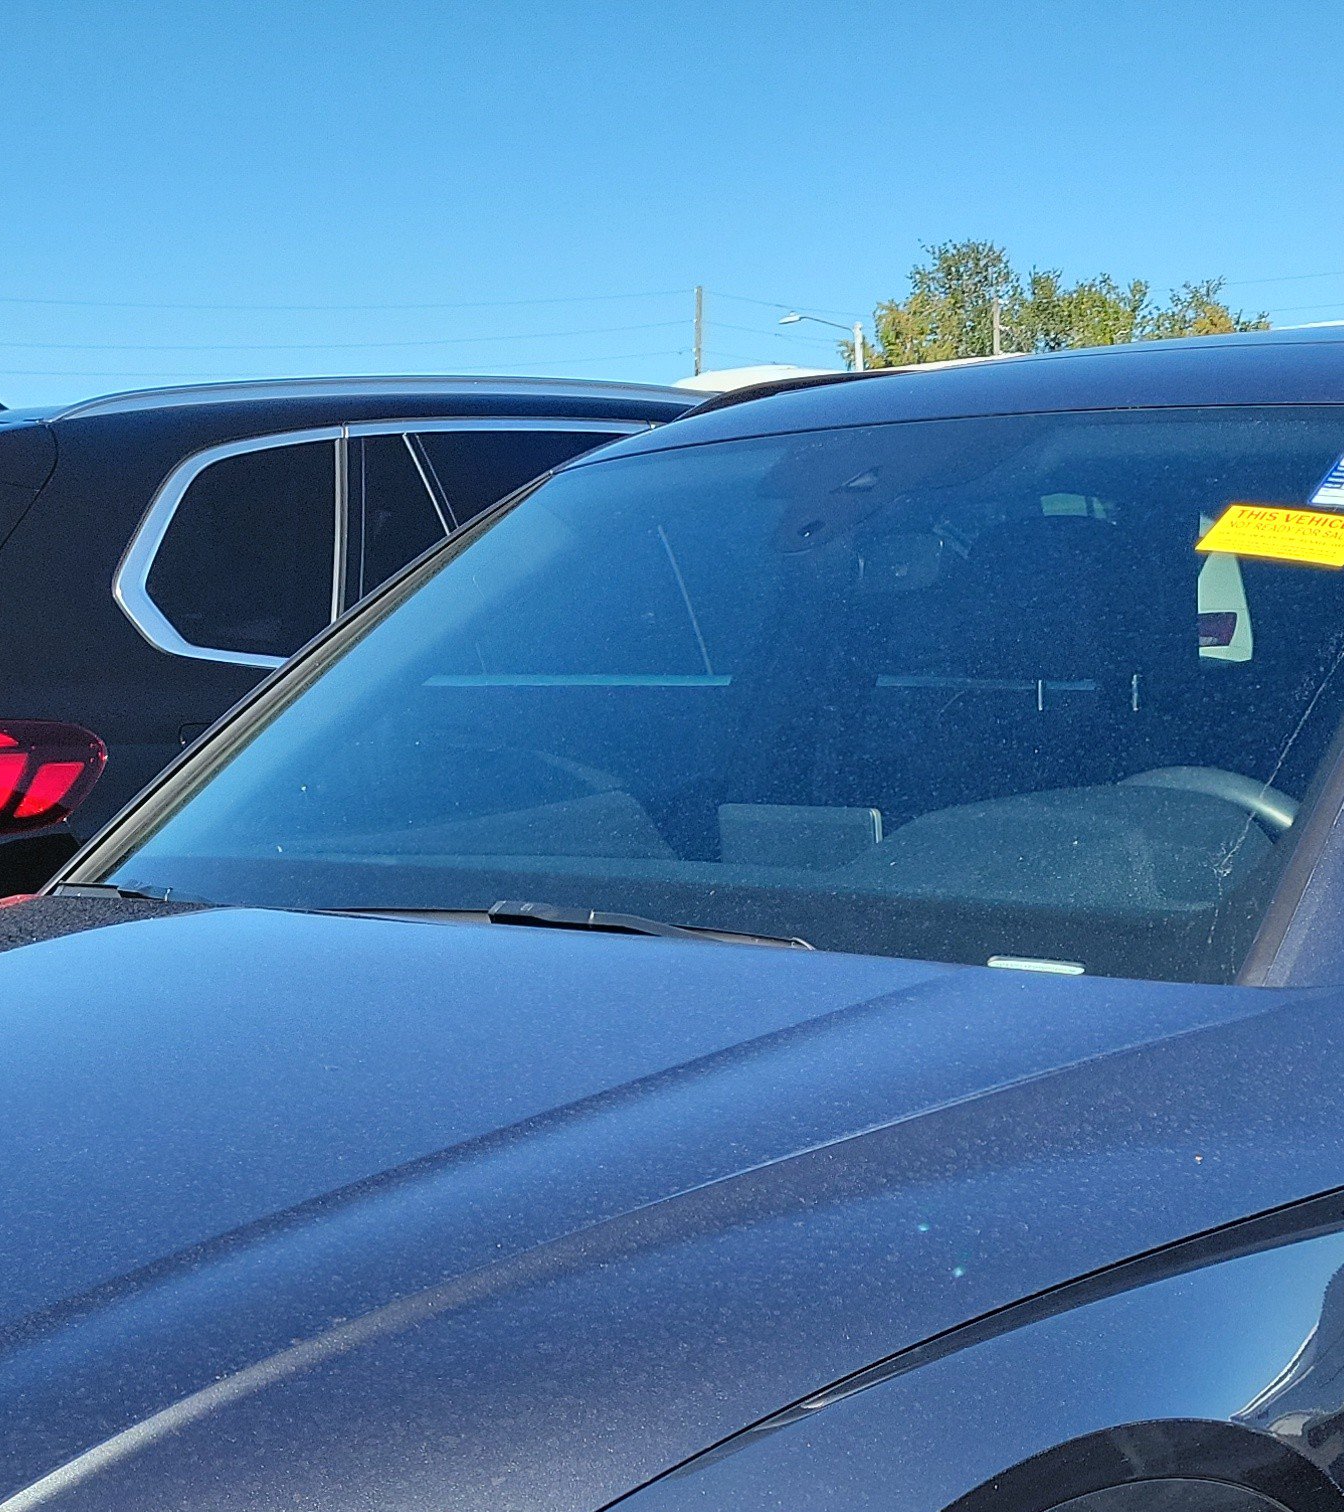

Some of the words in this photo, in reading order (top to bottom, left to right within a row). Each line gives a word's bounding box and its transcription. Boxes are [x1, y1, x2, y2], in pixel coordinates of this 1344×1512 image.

[1237, 509, 1280, 522] THIS
[1229, 520, 1251, 529] NOT
[1255, 522, 1295, 534] READY
[1297, 526, 1321, 537] FOR
